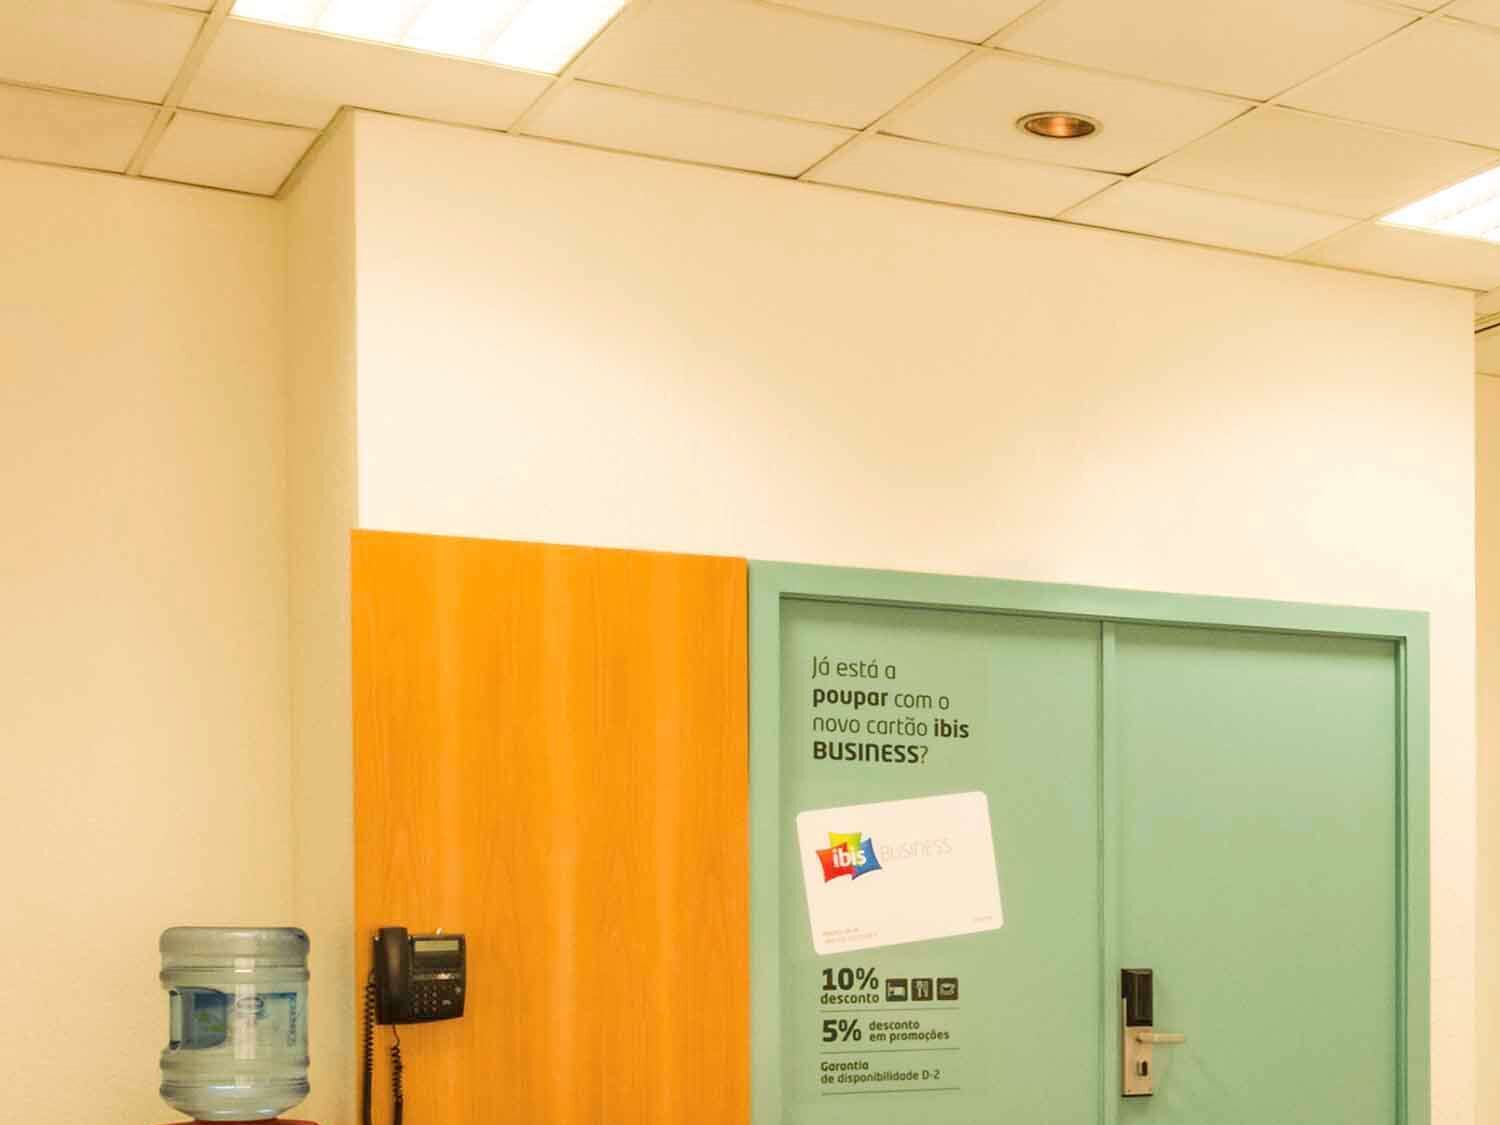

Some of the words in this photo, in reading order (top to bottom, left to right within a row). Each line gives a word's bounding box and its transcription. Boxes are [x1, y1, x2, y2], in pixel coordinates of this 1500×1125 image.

[812, 656, 830, 679] Já
[836, 659, 879, 679] está
[885, 664, 896, 680] a
[812, 688, 889, 709] poupar
[894, 693, 932, 709] com
[938, 695, 950, 710] o
[812, 716, 861, 734] novo
[866, 716, 928, 737] cartão
[933, 718, 969, 738] ibis
[812, 741, 929, 764] BUSINESS?
[831, 844, 867, 868] ibis
[821, 967, 879, 991] 10%
[820, 992, 880, 1005] desconto
[821, 1018, 862, 1042] 5%
[868, 1020, 920, 1031] desconto
[868, 1033, 887, 1042] em
[889, 1029, 950, 1044] promoções
[820, 1060, 869, 1072] Garantia
[820, 1074, 834, 1084] de
[837, 1070, 919, 1085] disponibilidade
